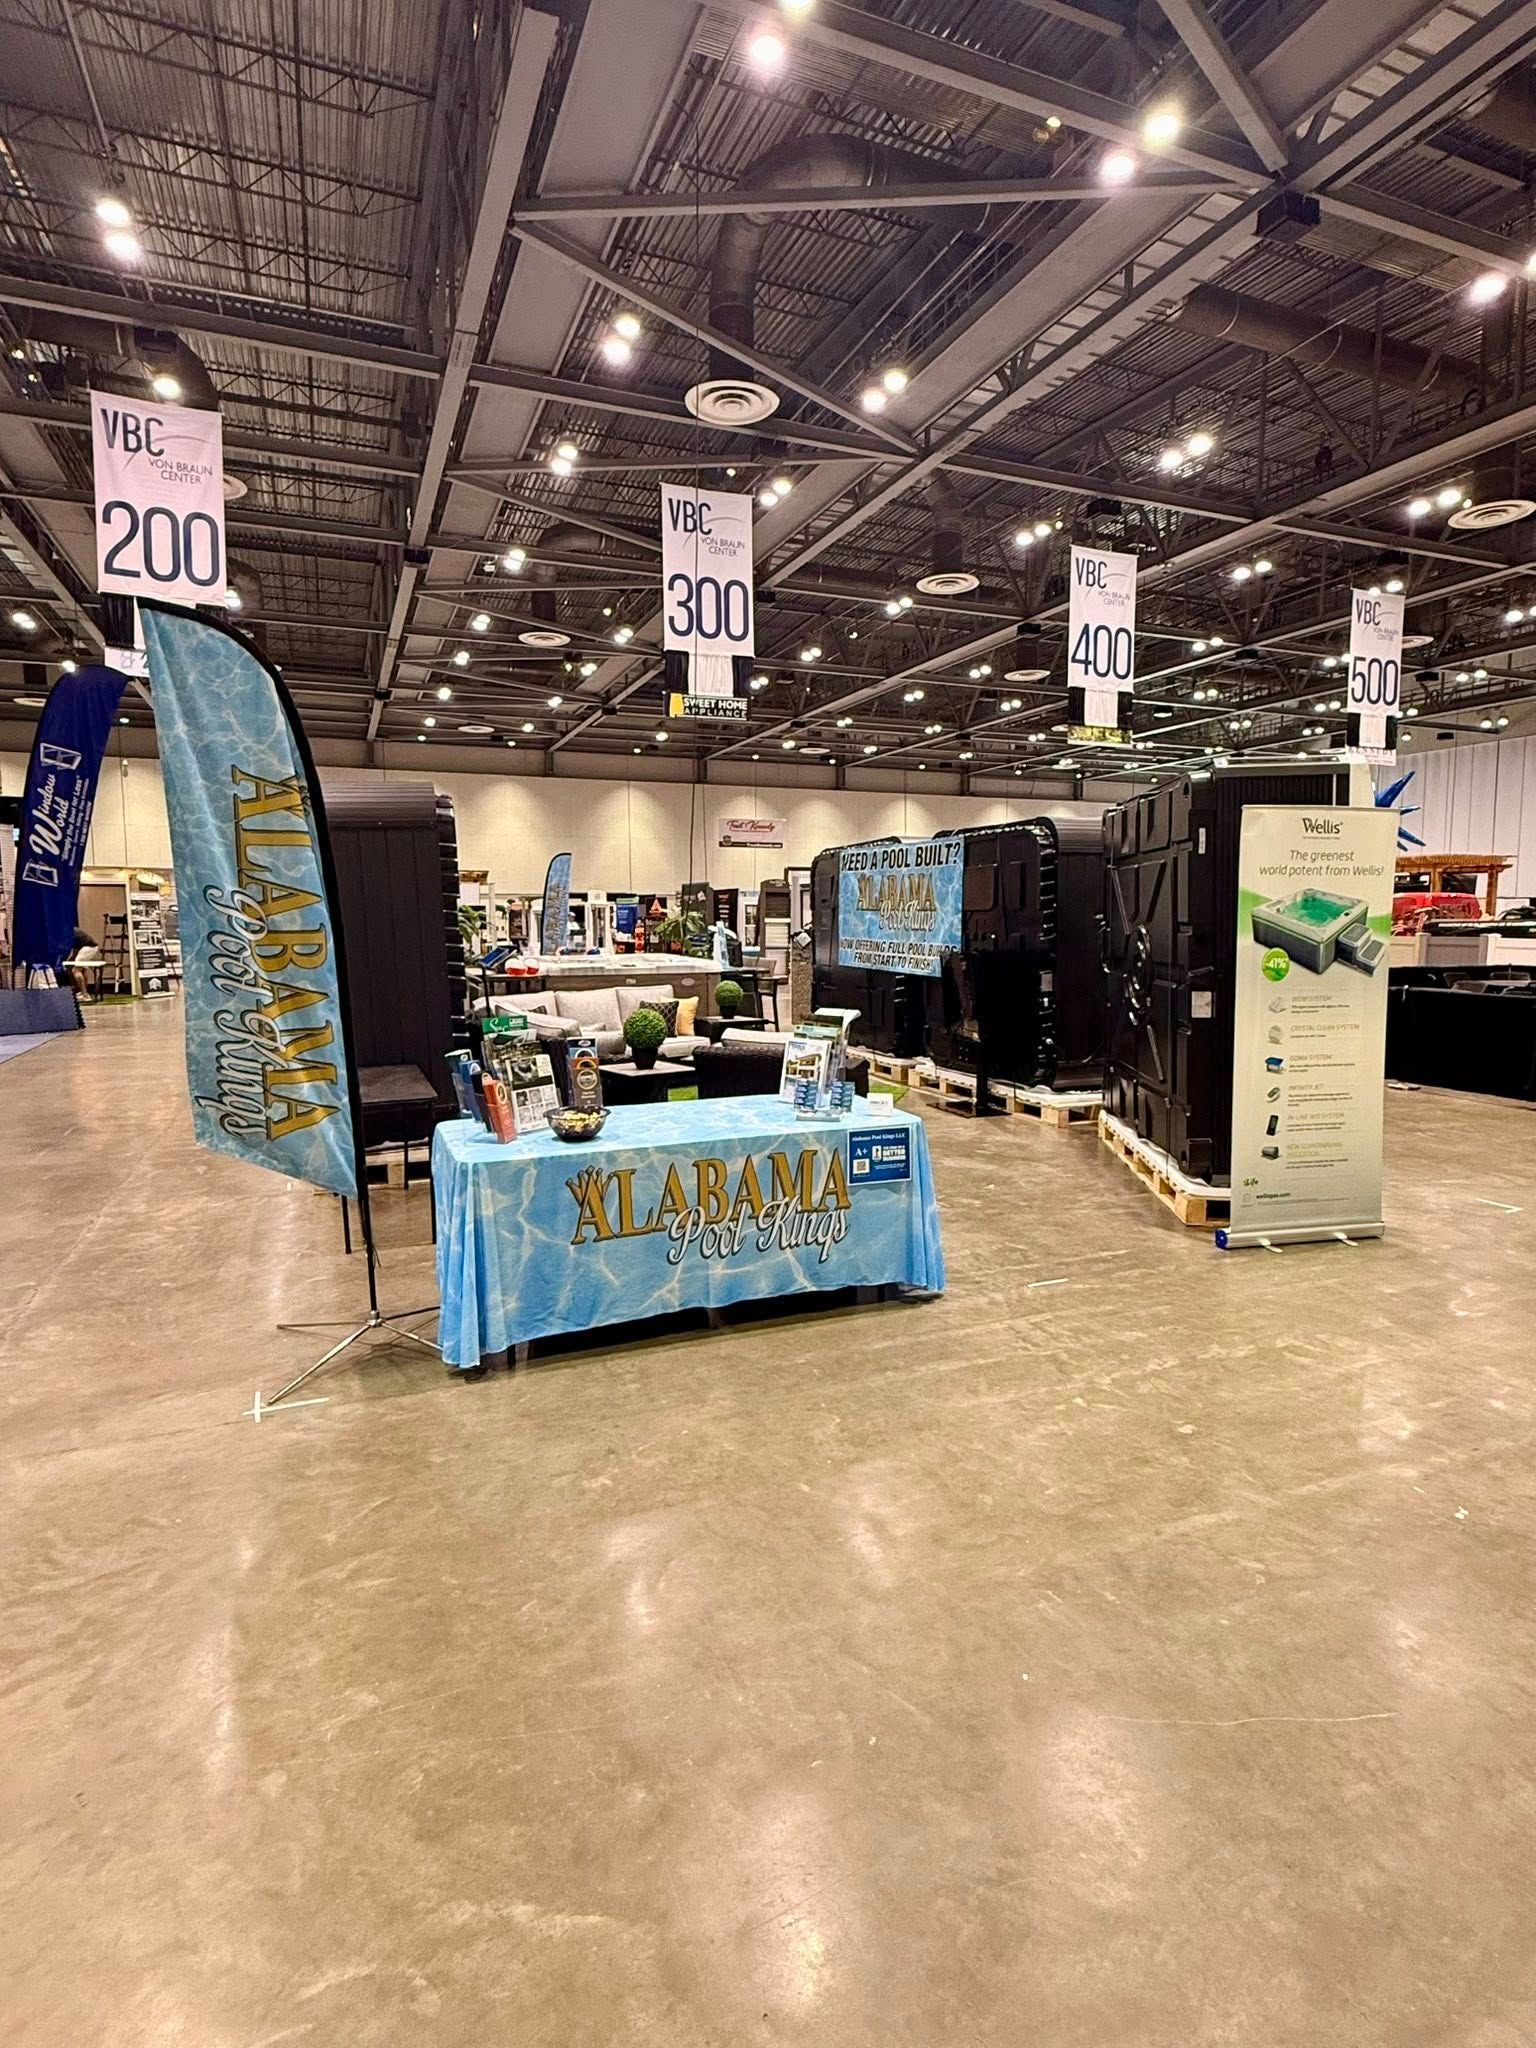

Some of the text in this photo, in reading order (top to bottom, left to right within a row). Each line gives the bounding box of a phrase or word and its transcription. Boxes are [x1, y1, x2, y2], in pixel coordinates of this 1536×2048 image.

[101, 408, 165, 457] VBC
[148, 458, 213, 476] VON BRAUN
[160, 470, 202, 485] CENTER
[668, 498, 712, 535] VBC
[102, 501, 220, 587] 200
[701, 537, 745, 549] VON BRAUN
[709, 546, 738, 557] CENTER
[1075, 557, 1107, 589] VBC
[668, 573, 749, 641] 300
[1356, 598, 1381, 626] VBC
[1071, 623, 1132, 679] 400
[1352, 657, 1398, 706] 500
[684, 698, 748, 711] SWEET HOME
[684, 706, 747, 719] APPLIANCE
[1301, 817, 1340, 834] Wellis
[841, 842, 961, 871] NEED A POOL BUILT?
[1290, 850, 1355, 863] The greenest
[1260, 865, 1385, 878] world patent from Wellis!
[856, 872, 937, 911] ALABAMA
[232, 764, 342, 1142] ALABAMA
[854, 951, 872, 963] FROM
[873, 953, 896, 966] START
[897, 956, 909, 968] TO
[855, 939, 886, 952] OFFERING
[887, 941, 905, 954] FULL
[908, 943, 926, 956] POOL
[195, 883, 288, 1141] Pool Kings
[1336, 1023, 1360, 1031] SYSTEM
[855, 1147, 869, 1157] A+
[565, 1147, 852, 1246] ALABAMA
[666, 1195, 852, 1265] Pool Kings
